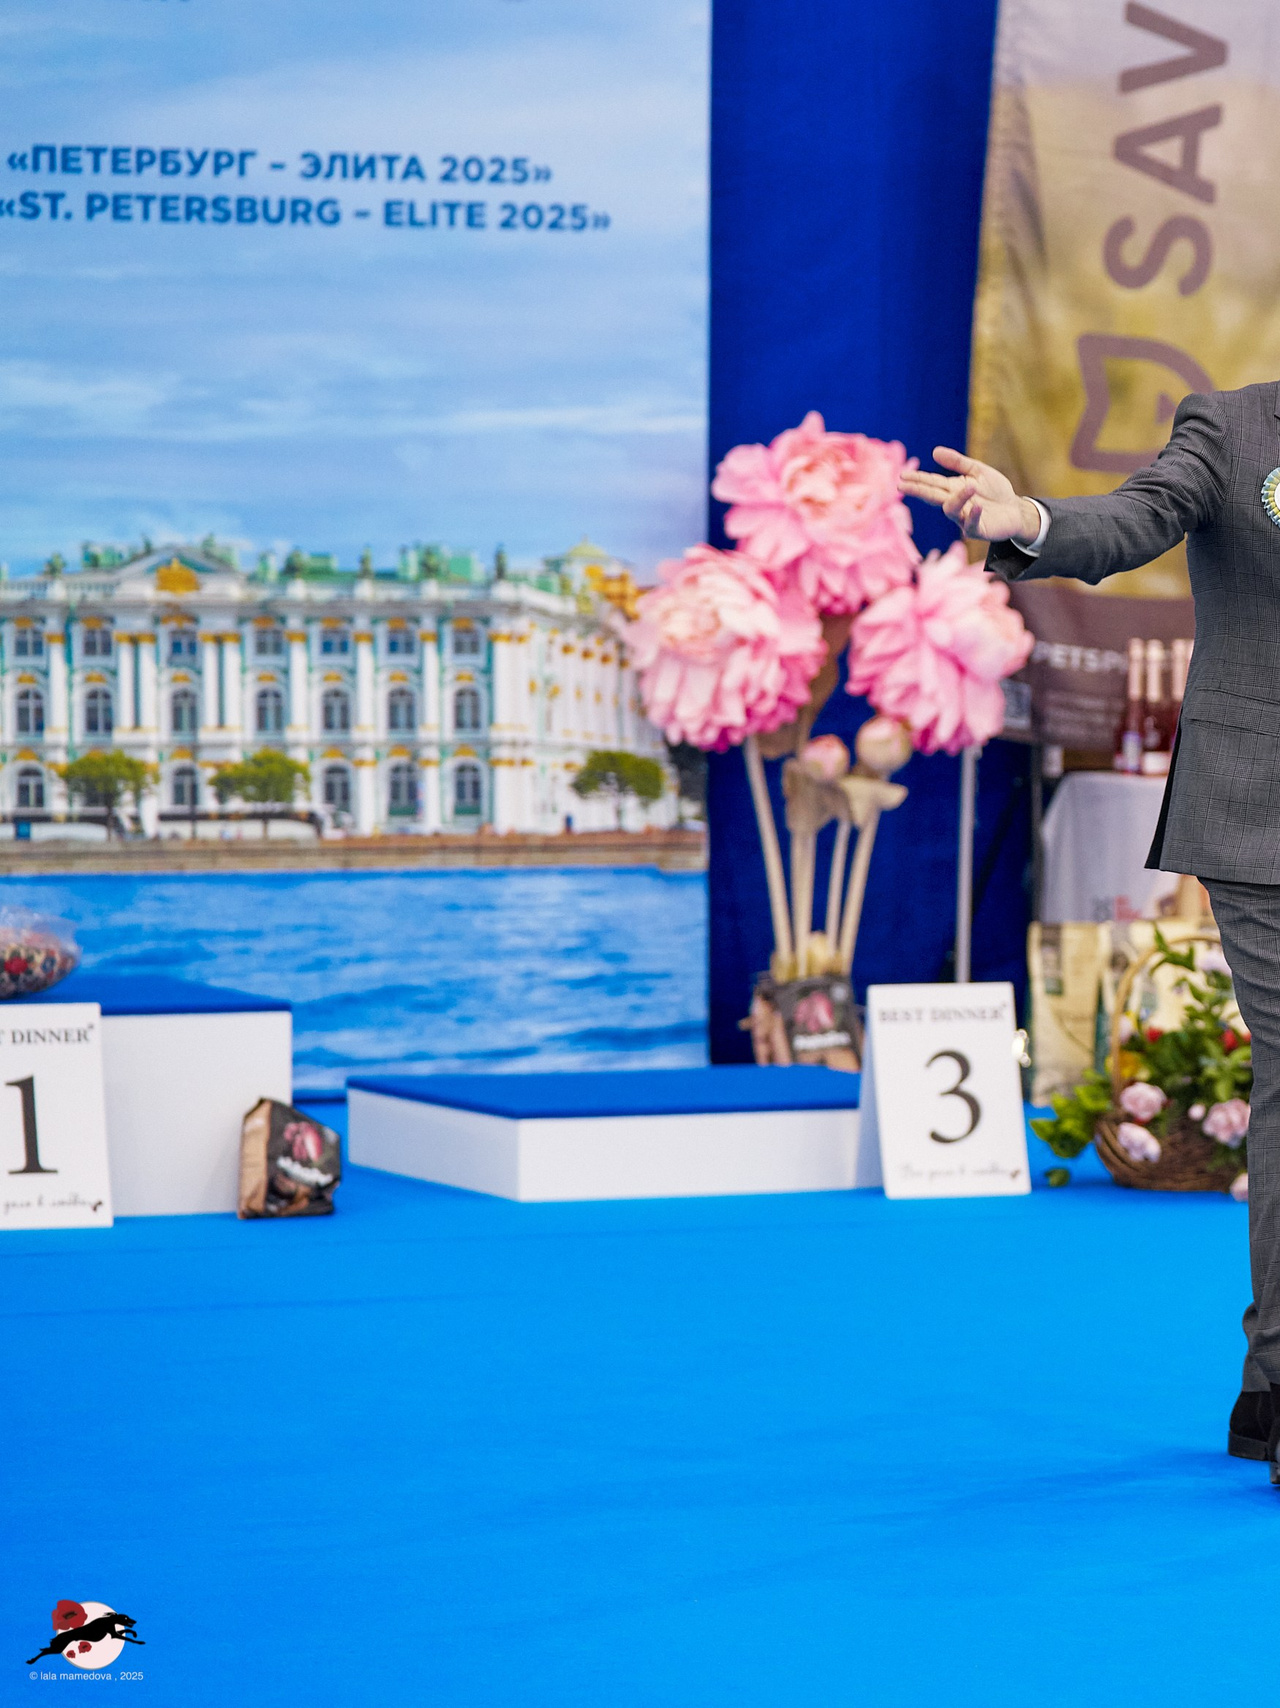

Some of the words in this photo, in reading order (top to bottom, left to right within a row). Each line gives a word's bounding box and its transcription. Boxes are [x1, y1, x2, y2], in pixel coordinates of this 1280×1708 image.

[6, 144, 258, 180] «ПЕТЕРБУРГ
[299, 151, 426, 183] ЭЛИТА
[439, 156, 552, 185] 2025»
[85, 193, 342, 227] PETERSBURG
[383, 199, 487, 229] ELITE
[500, 202, 611, 232] 2025»
[5, 1074, 59, 1175] 1
[925, 1048, 982, 1145] 3
